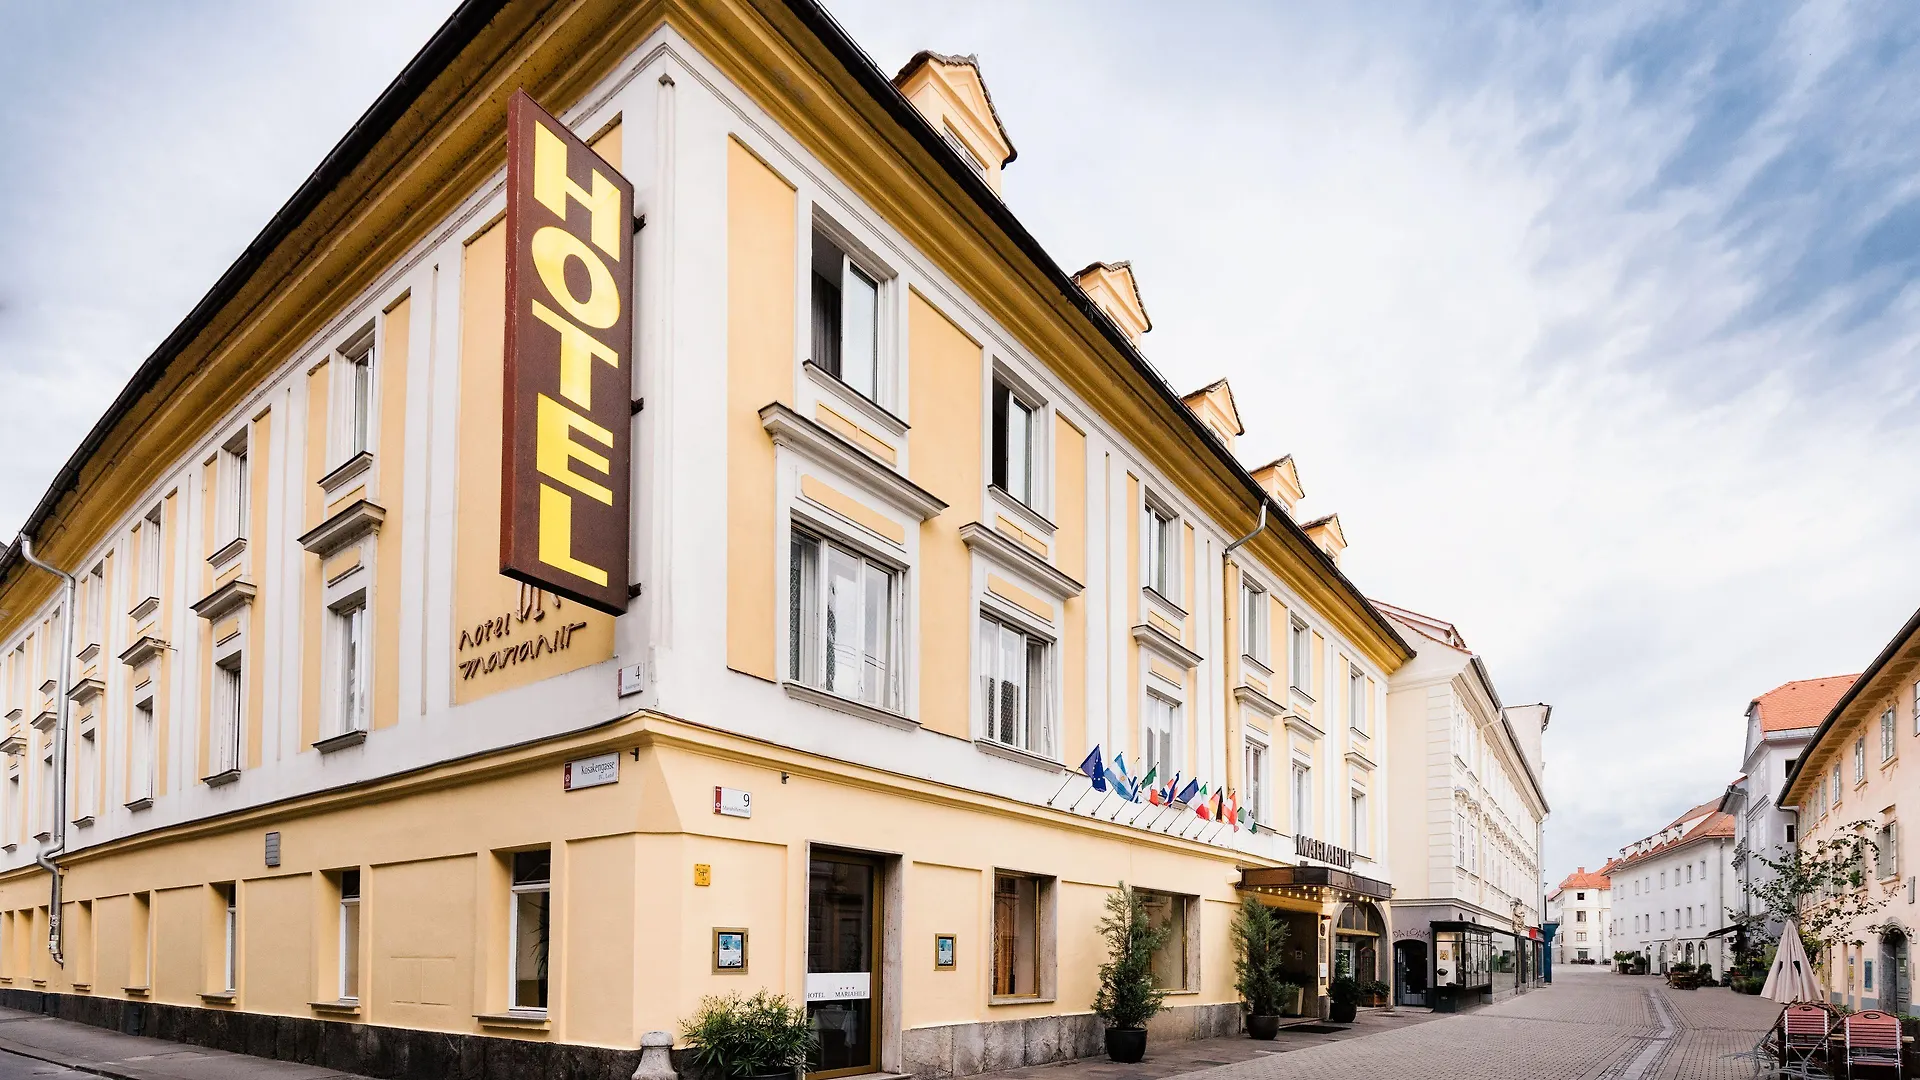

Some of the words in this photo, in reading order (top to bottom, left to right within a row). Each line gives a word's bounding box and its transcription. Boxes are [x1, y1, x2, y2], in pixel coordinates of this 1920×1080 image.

[531, 120, 621, 587] HOTEL
[635, 665, 641, 680] 4
[580, 761, 615, 775] Kosakengasse
[743, 793, 750, 808] 9
[1295, 833, 1354, 869] MARIAHILF
[834, 990, 866, 998] MARIAHILF
